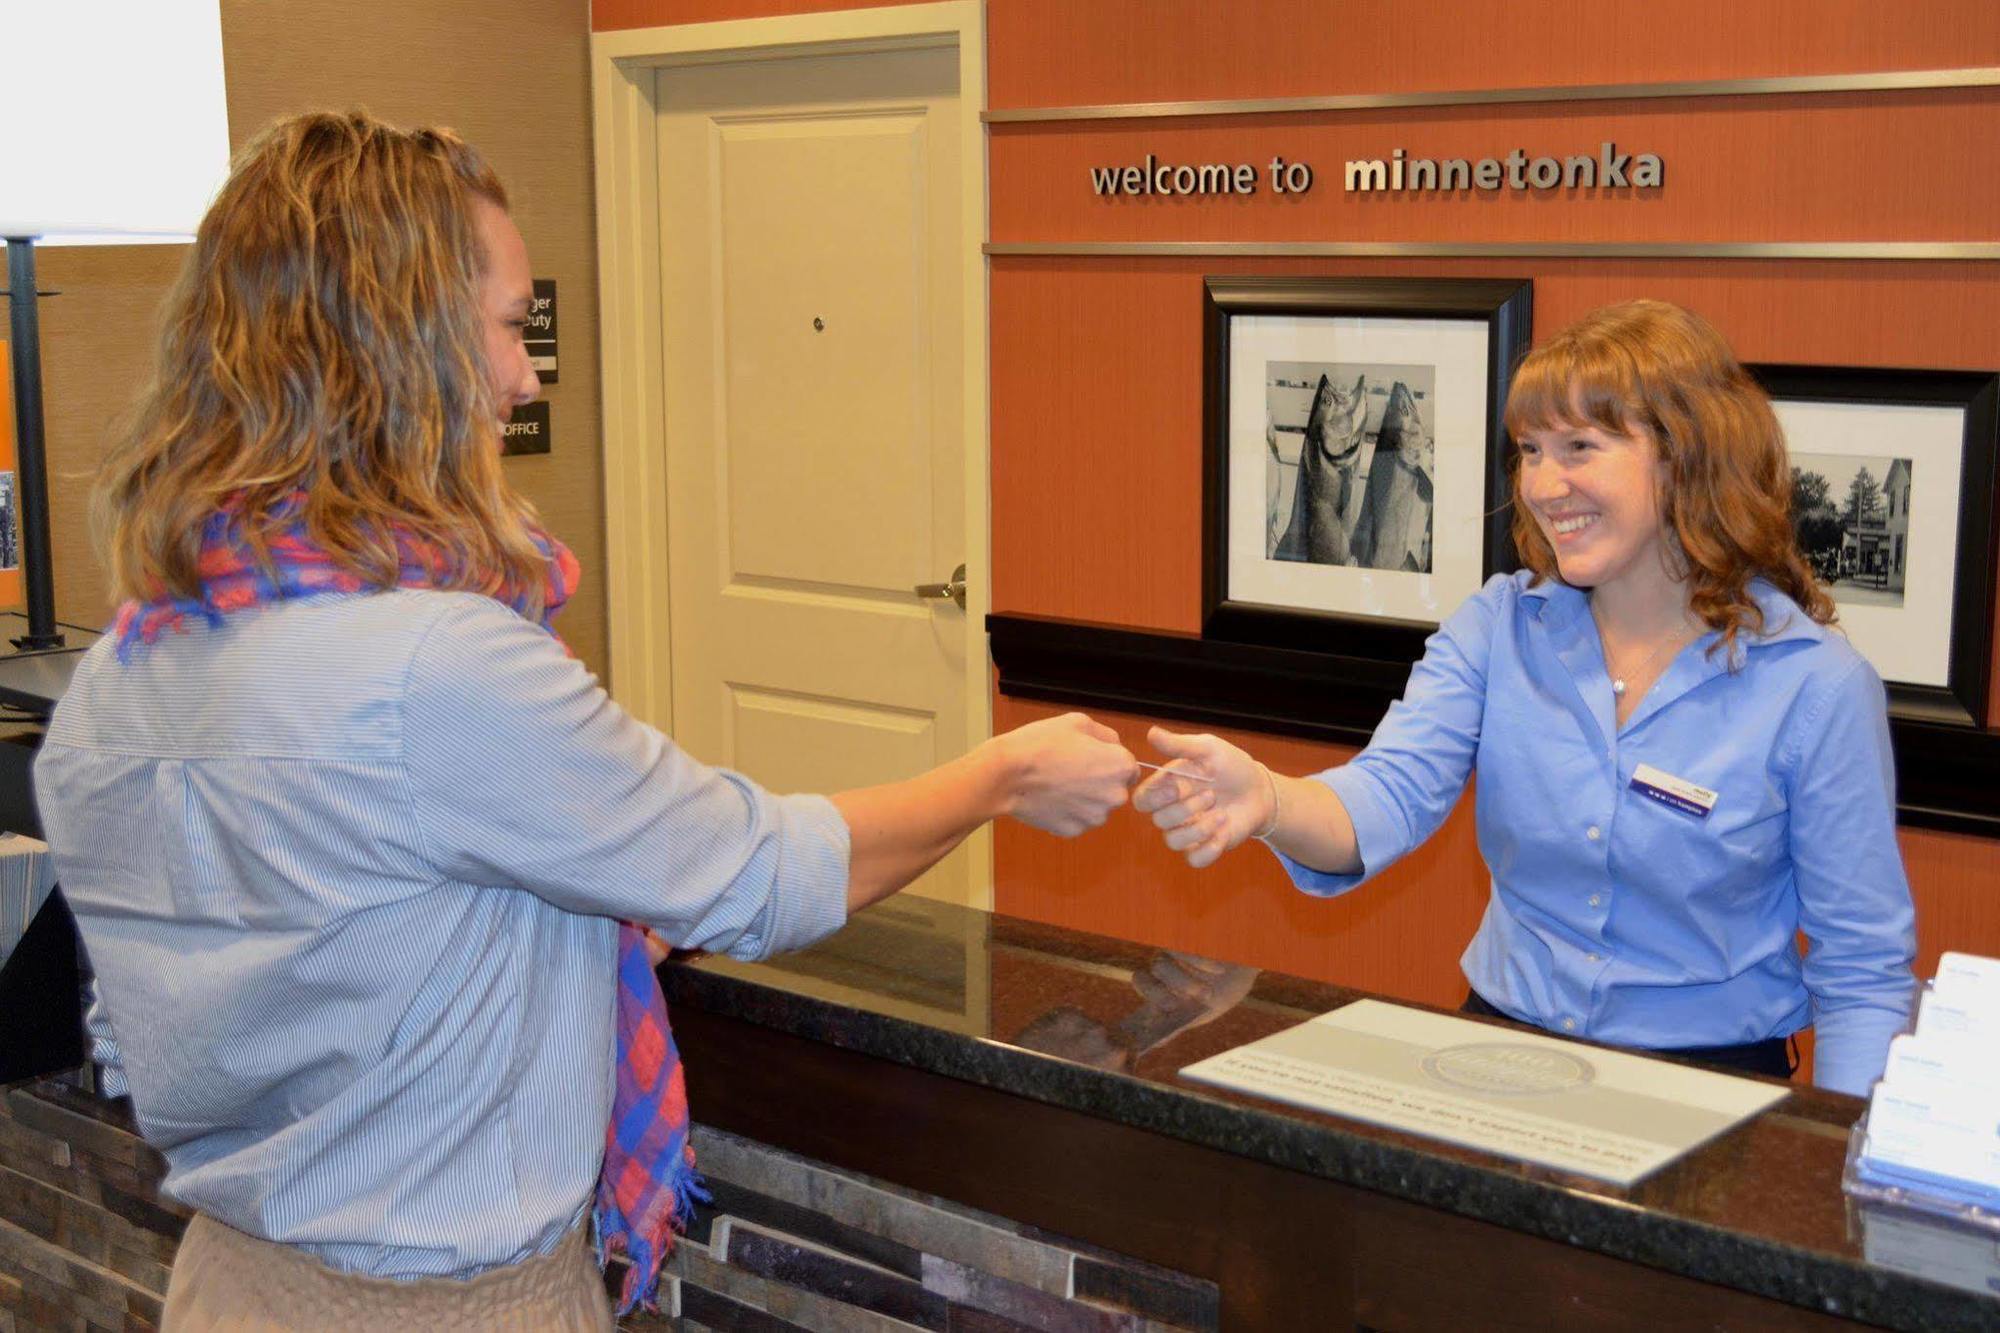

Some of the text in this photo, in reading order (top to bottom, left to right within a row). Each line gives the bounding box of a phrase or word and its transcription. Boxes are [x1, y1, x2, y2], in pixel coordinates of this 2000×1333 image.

[1090, 142, 1663, 195] welcome to minnetonka
[504, 421, 539, 436] OFFICE
